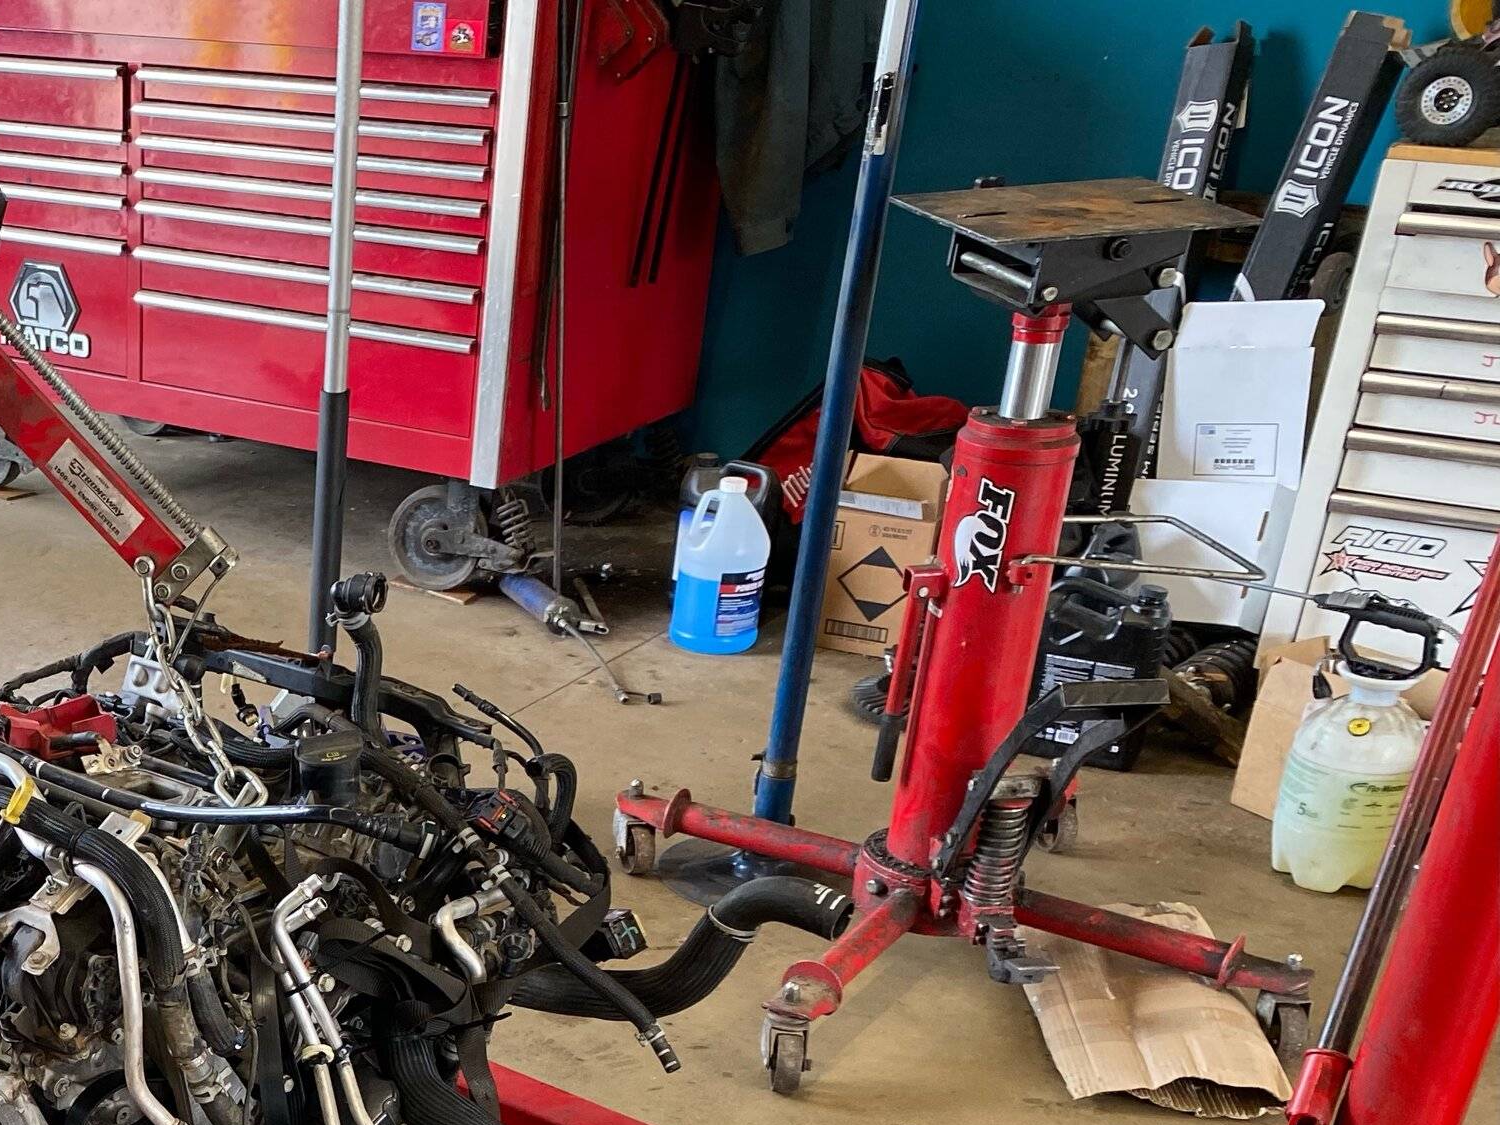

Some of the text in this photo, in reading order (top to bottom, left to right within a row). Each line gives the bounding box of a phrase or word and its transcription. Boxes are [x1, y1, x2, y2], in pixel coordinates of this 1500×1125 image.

[1174, 138, 1206, 195] ICO
[1210, 103, 1235, 179] ICON
[1294, 96, 1349, 178] ICON
[1319, 102, 1359, 179] VEHICLE DYNAMICS
[0, 326, 90, 358] ATCO
[77, 491, 98, 512] ENGINE
[98, 511, 121, 536] LEVELER
[1097, 434, 1128, 517] LUMINUM
[968, 477, 1016, 594] FOX
[1331, 525, 1448, 559] RIGID
